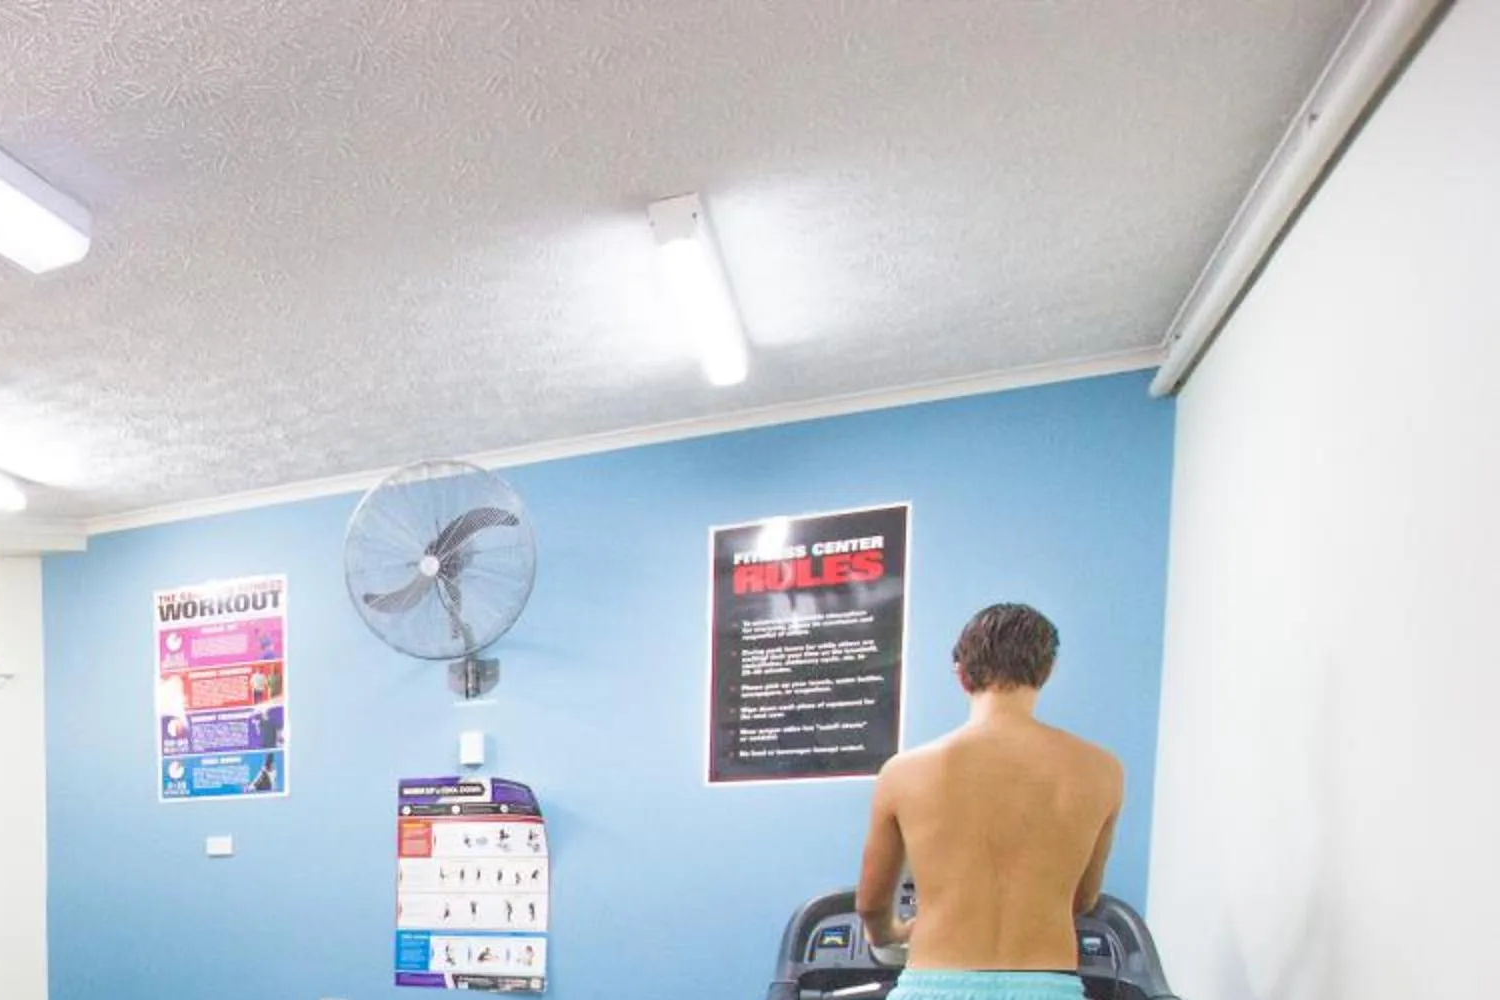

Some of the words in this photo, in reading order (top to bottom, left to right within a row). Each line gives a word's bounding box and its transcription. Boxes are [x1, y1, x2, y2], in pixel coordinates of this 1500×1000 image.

[812, 536, 884, 556] CENTER
[733, 550, 884, 595] RULES
[158, 590, 282, 622] WORKOUT
